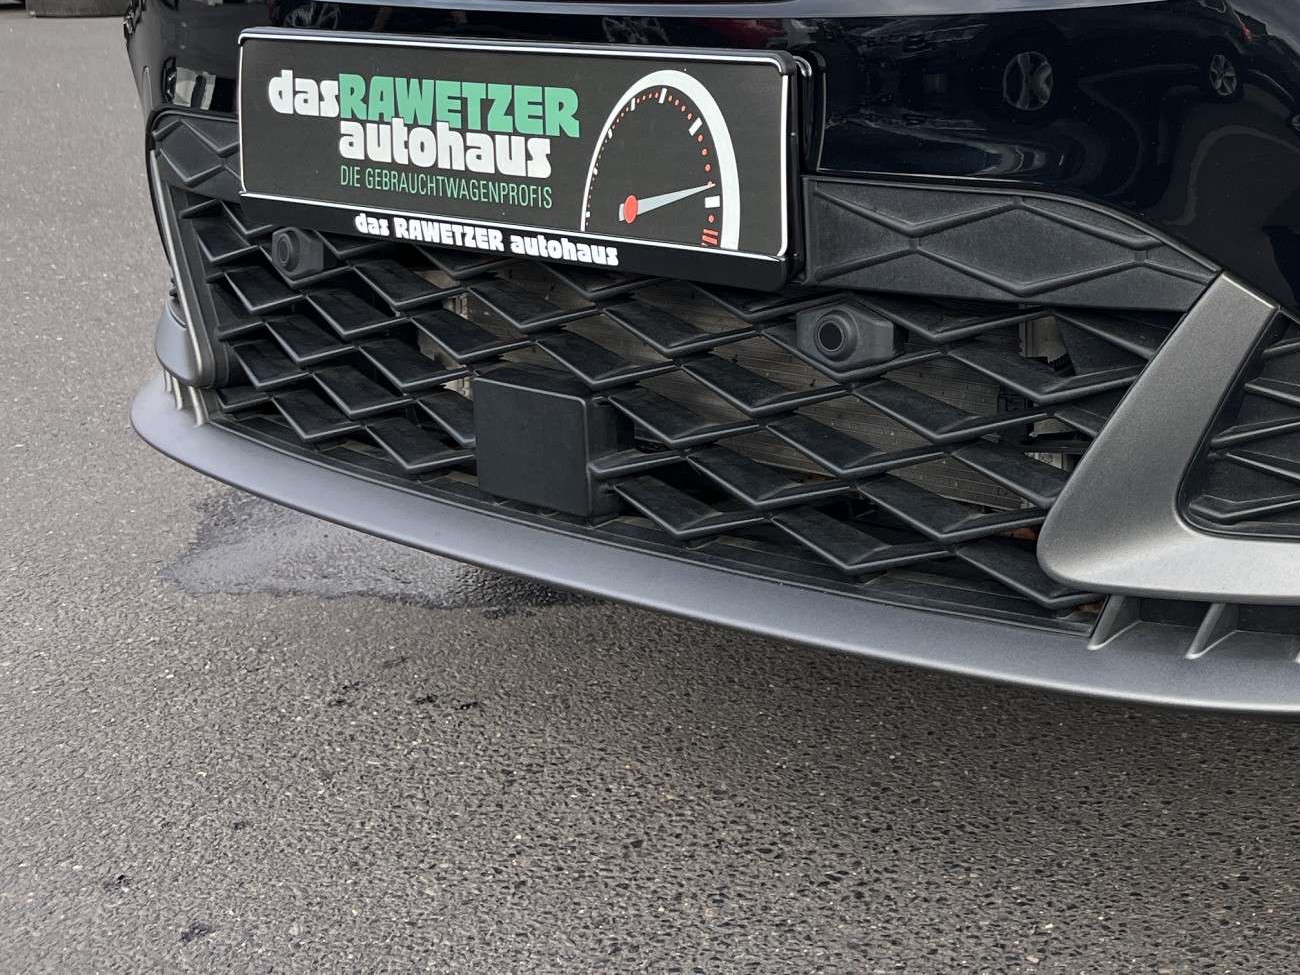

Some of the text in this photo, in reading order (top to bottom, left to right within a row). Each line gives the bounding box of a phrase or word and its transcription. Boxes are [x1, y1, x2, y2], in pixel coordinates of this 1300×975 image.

[339, 117, 552, 178] autohaus
[340, 165, 552, 209] DIE GEBRAUCHTWAGENPROFIS
[354, 213, 619, 266] das RAWETZER autohaus
